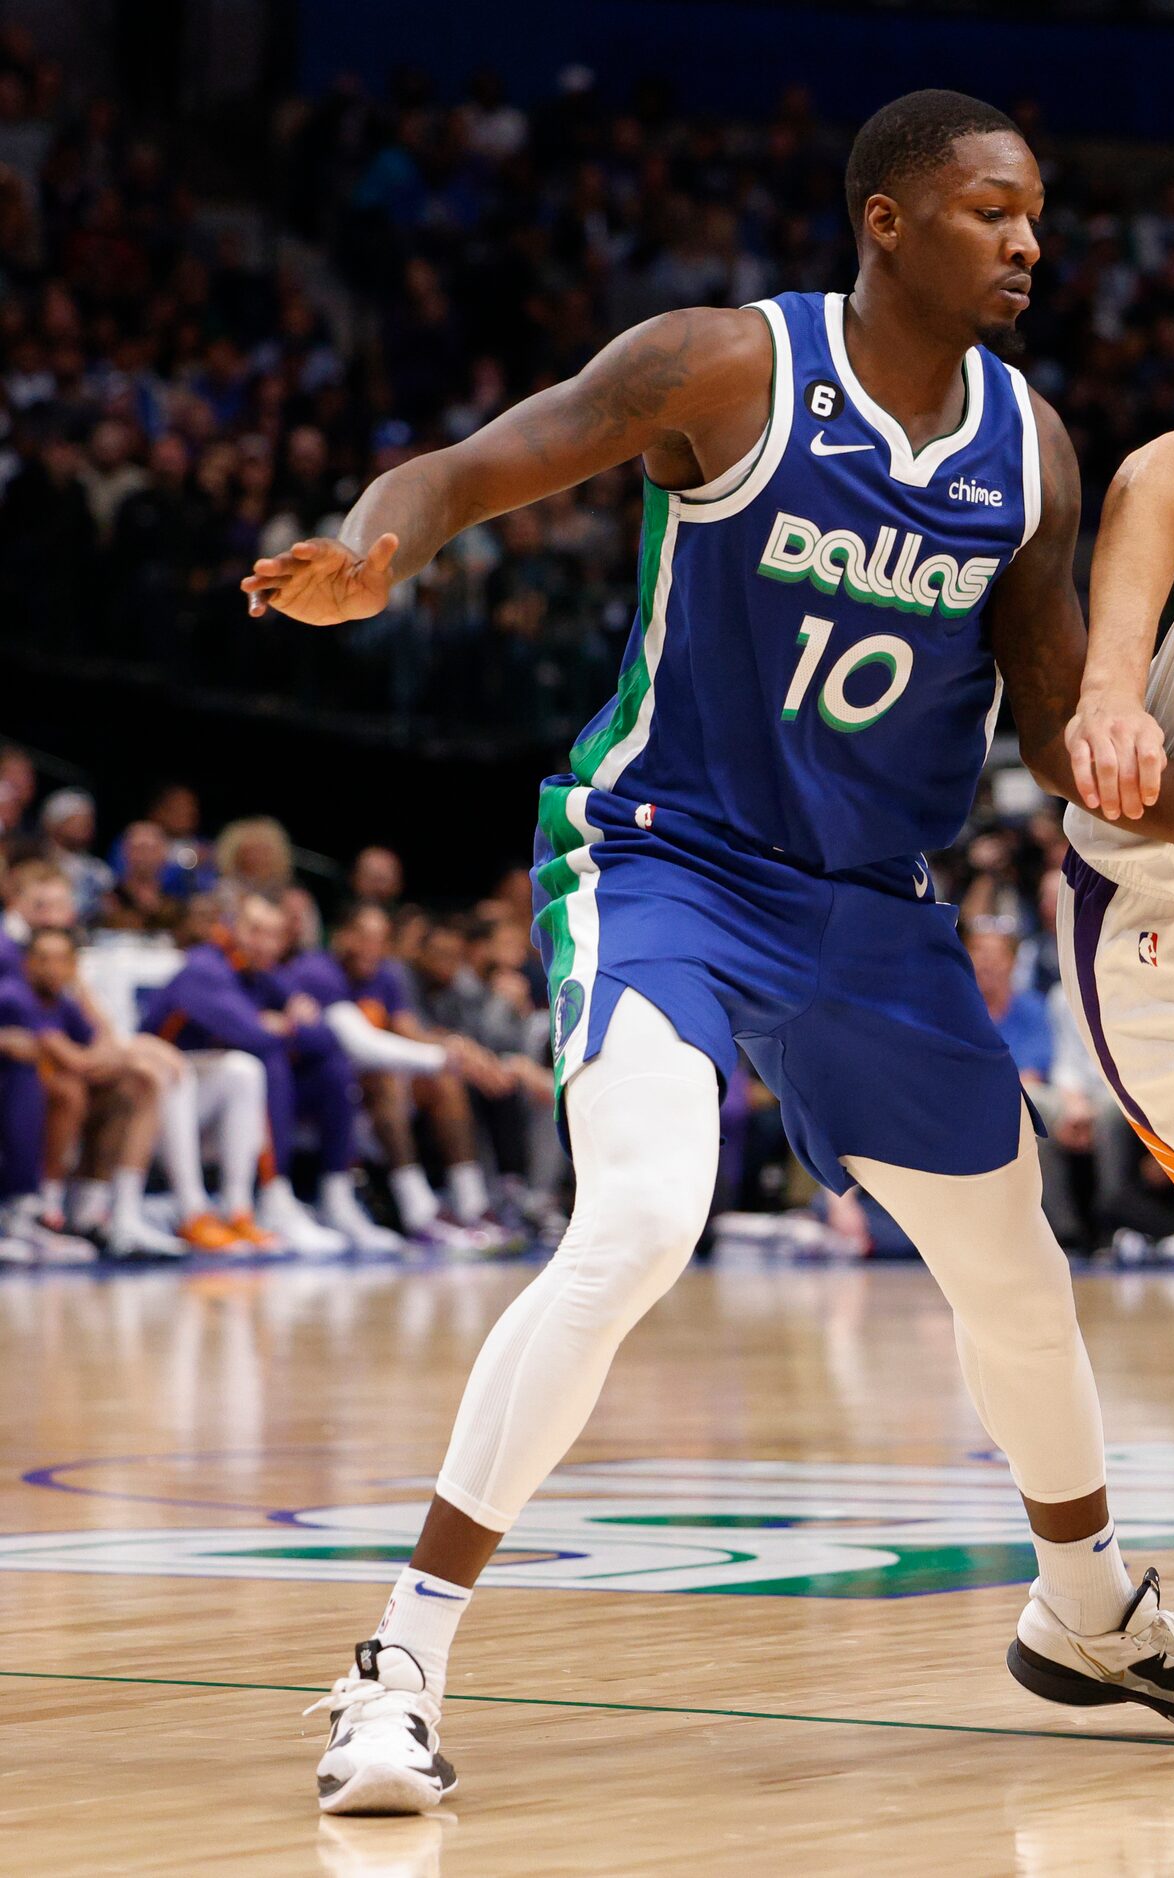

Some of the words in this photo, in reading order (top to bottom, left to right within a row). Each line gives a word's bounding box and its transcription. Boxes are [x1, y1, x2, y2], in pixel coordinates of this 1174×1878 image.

[811, 386, 836, 417] 6
[949, 478, 1002, 507] chime
[758, 512, 1000, 617] Dallas
[781, 614, 914, 732] 10
